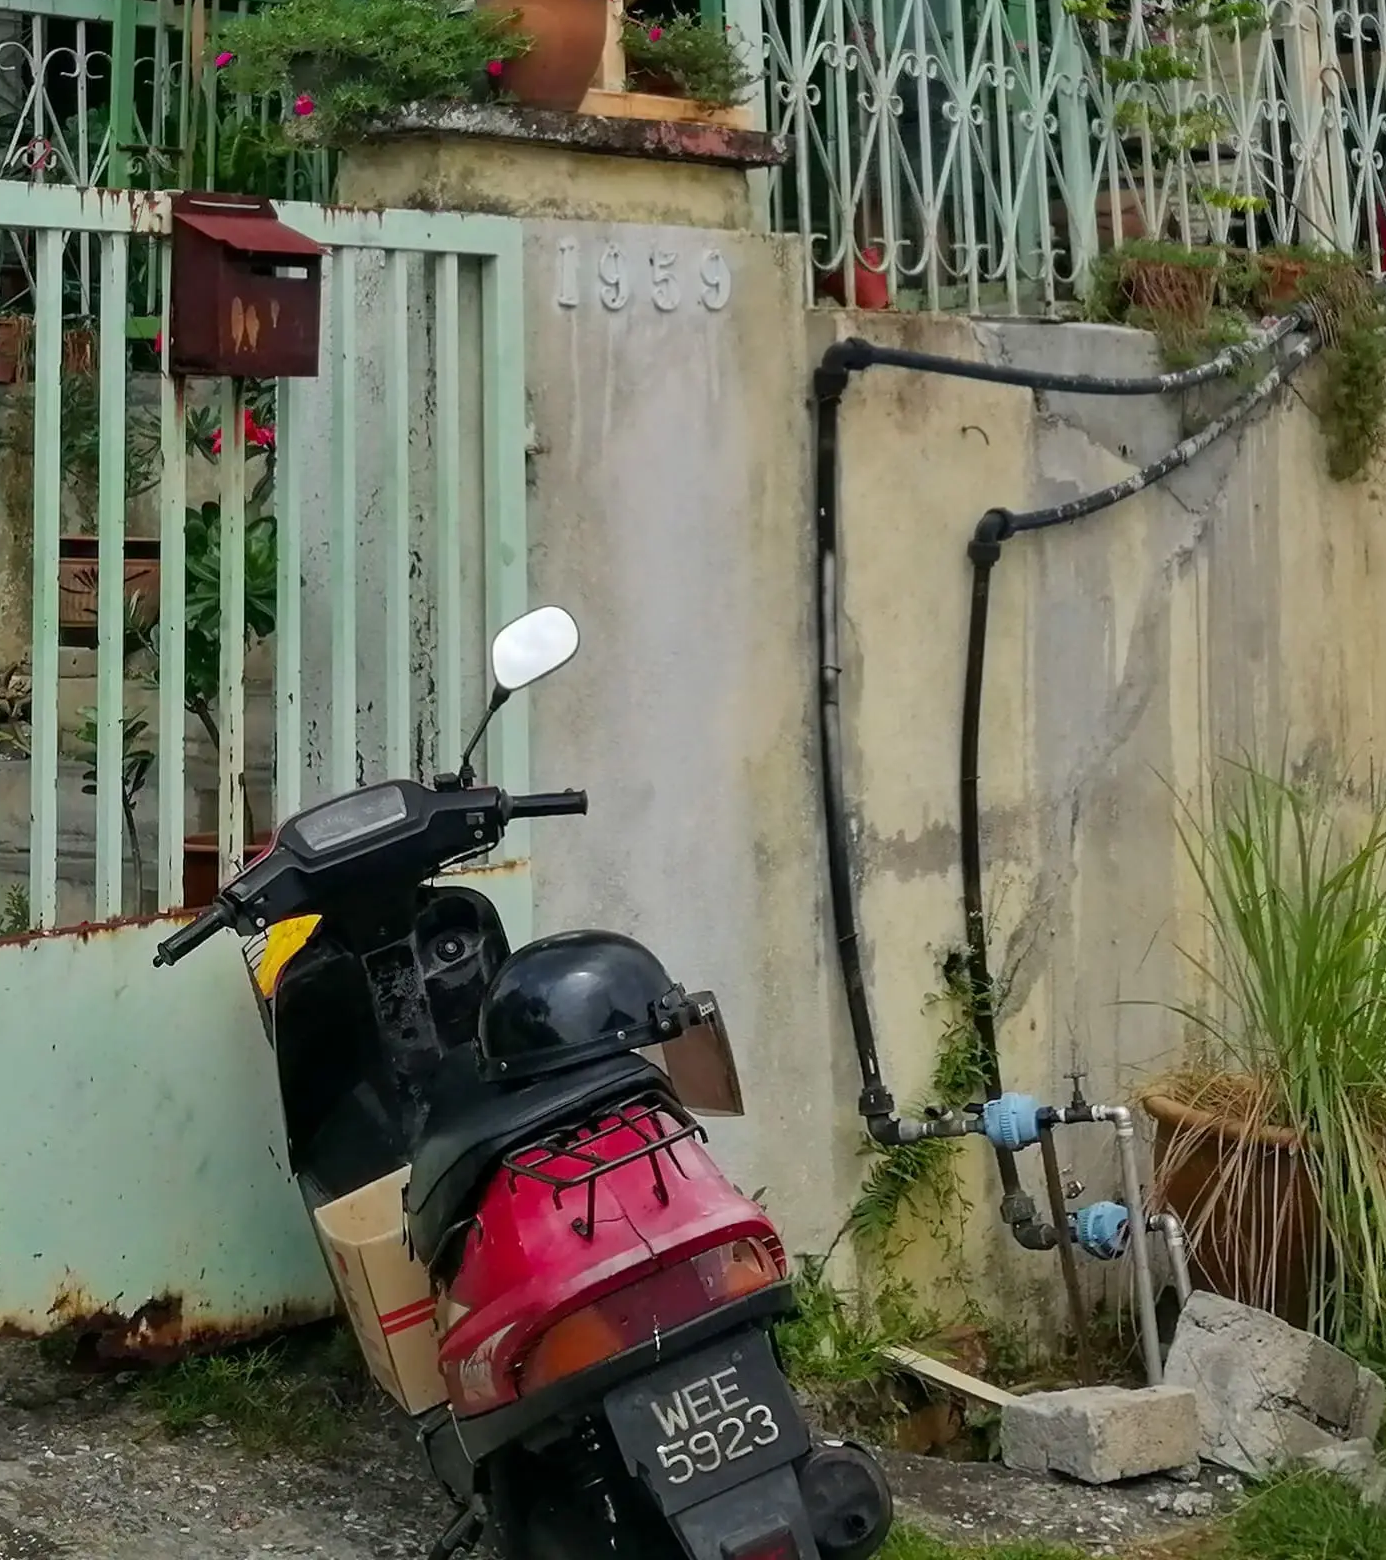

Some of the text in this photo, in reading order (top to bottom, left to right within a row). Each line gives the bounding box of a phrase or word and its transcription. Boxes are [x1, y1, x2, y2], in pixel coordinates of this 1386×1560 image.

[557, 238, 732, 311] 1959
[650, 1366, 749, 1438] WEE
[656, 1404, 779, 1484] 5923
